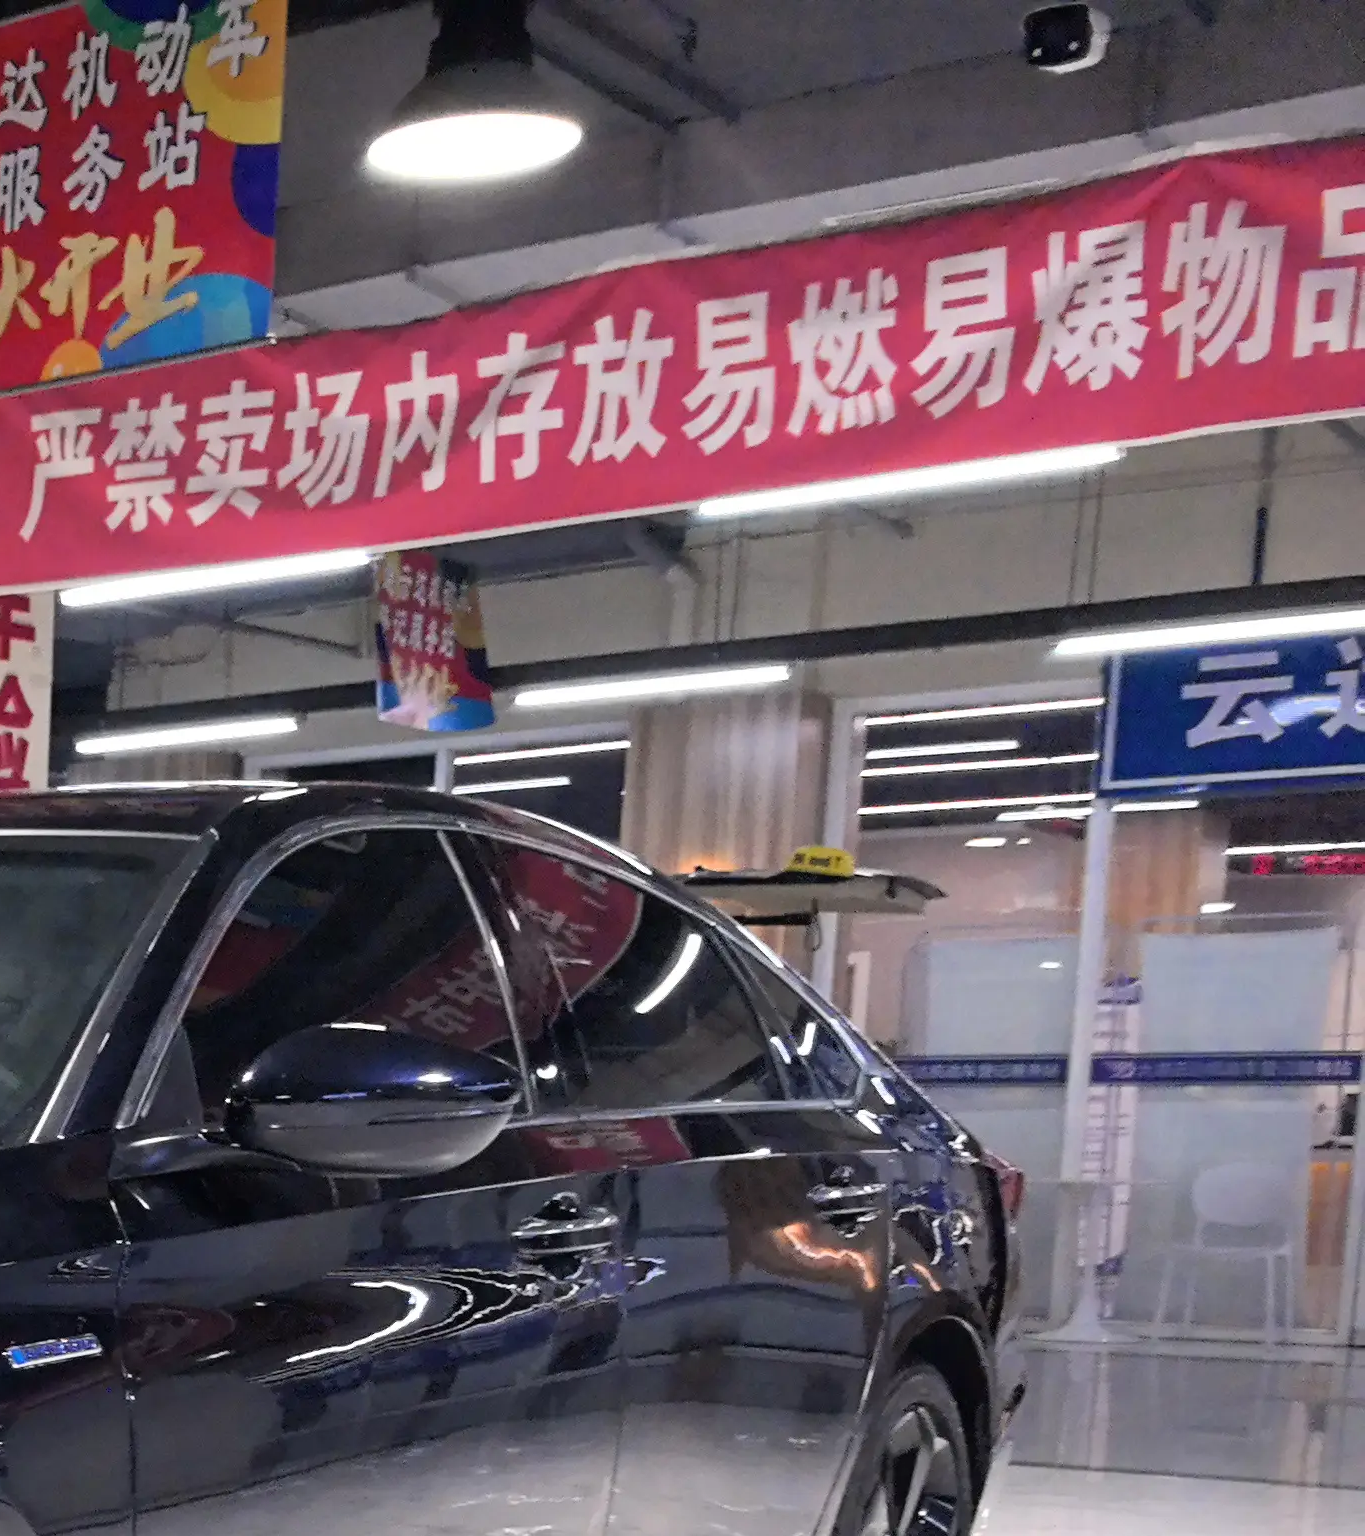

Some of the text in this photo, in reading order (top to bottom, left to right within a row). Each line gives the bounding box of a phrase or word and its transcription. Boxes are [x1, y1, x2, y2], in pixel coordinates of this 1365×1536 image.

[19, 184, 1365, 544] 严禁卖场内存放易燃易爆物品
